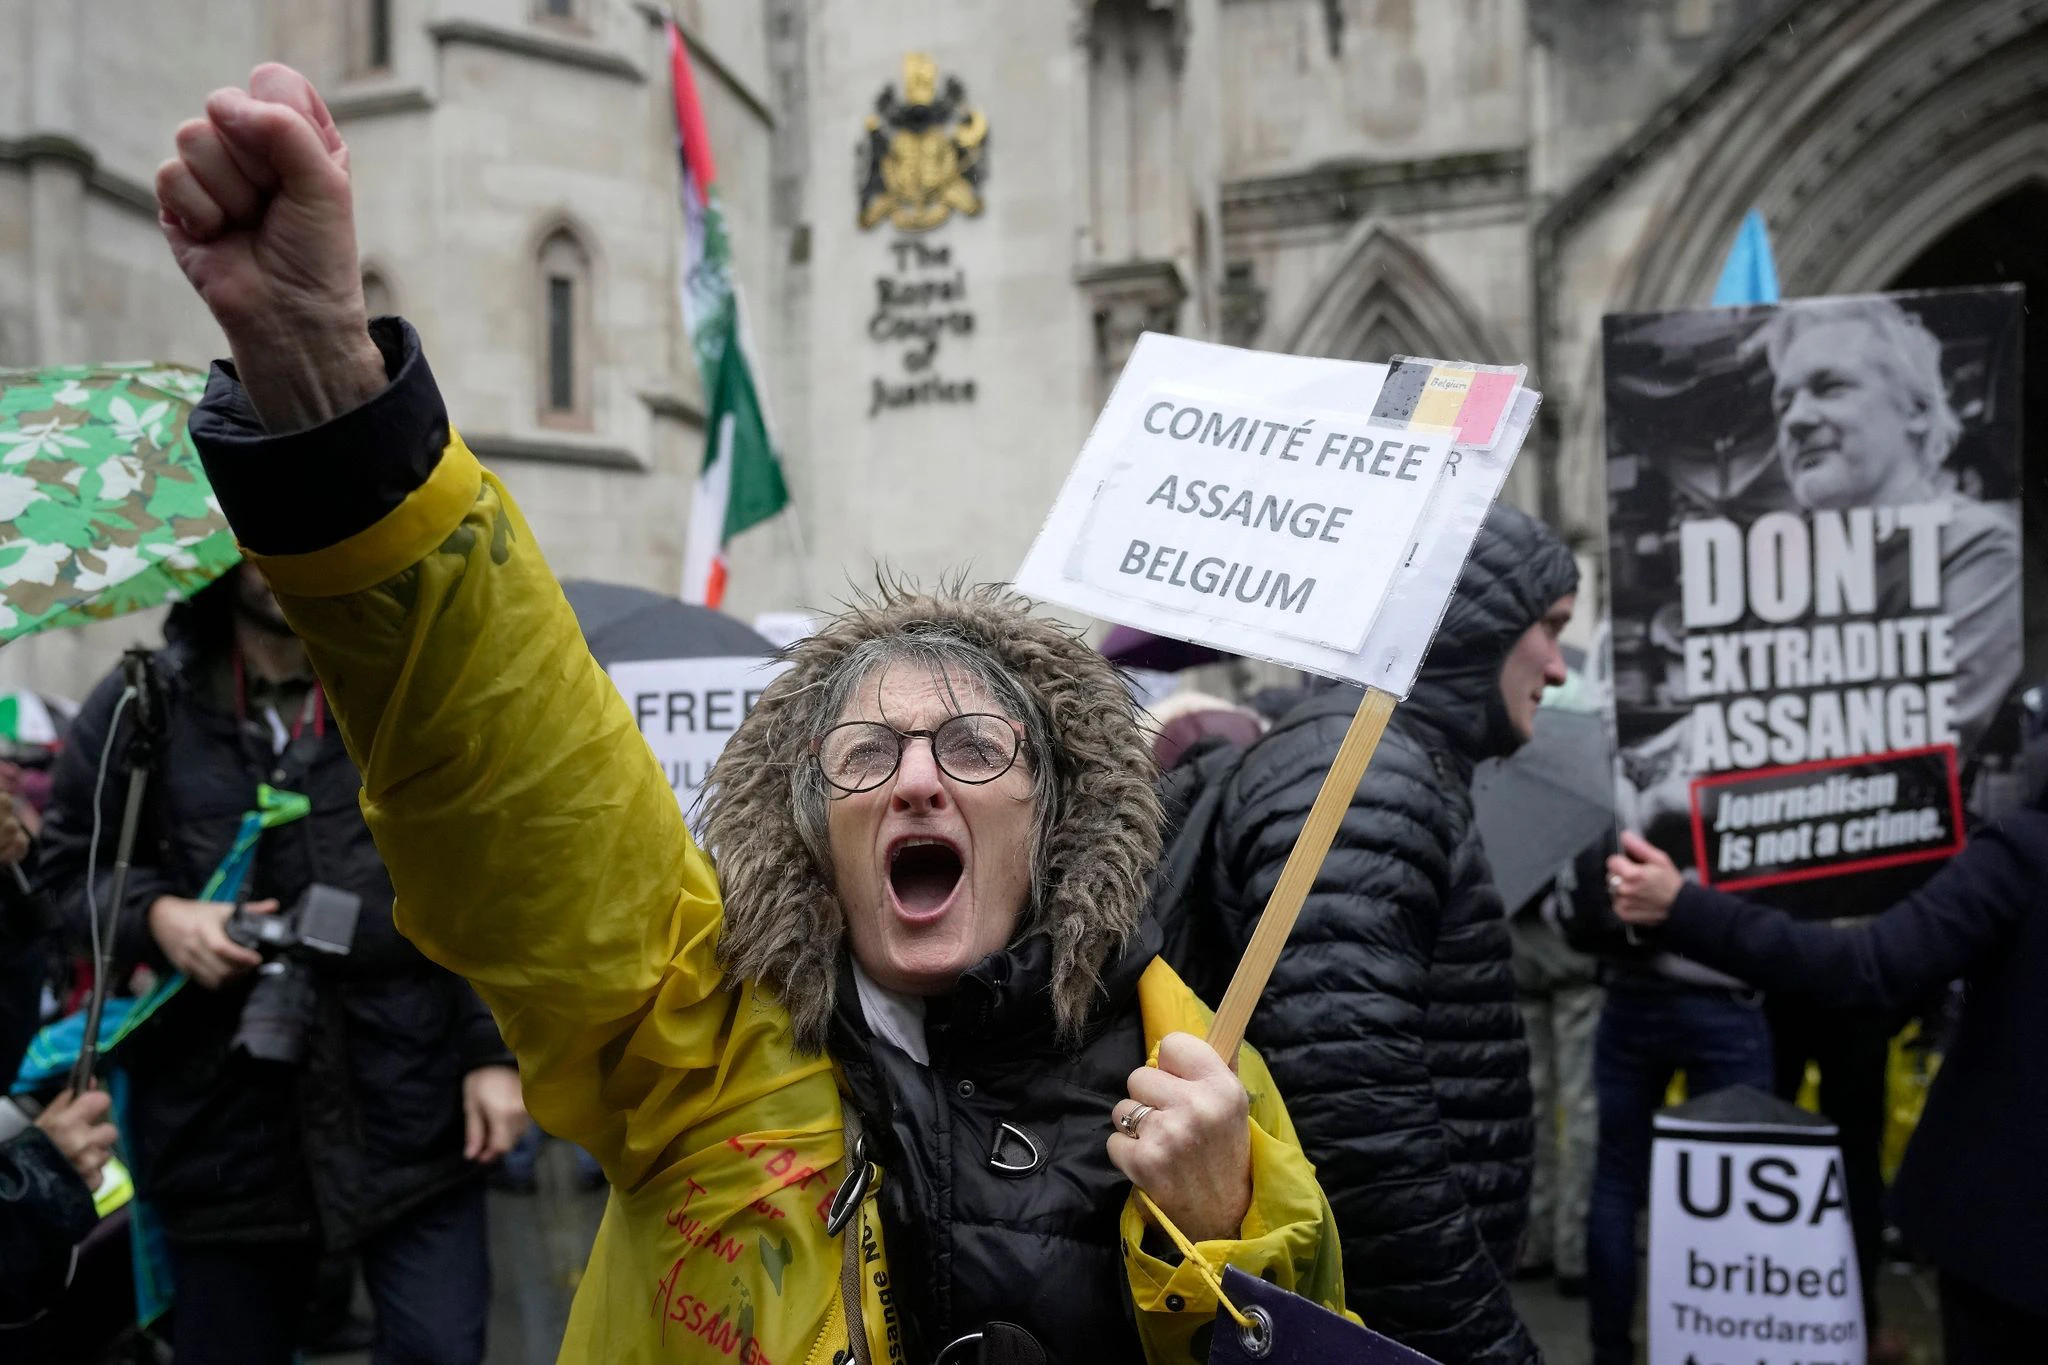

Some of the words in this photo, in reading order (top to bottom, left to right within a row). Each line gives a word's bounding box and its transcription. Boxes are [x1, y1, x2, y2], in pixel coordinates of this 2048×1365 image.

[1430, 376, 1468, 390] Belgium
[1143, 402, 1316, 461] COMITÉ
[1315, 433, 1430, 481] FREE
[1146, 474, 1353, 544] ASSANGE
[1119, 539, 1316, 614] BELGIUM
[1680, 504, 1953, 627] DON'T
[1684, 615, 1955, 696] EXTRADITE
[1689, 681, 1960, 772] ASSANGE
[1713, 773, 1898, 832] Journalism
[1718, 832, 1753, 872] is
[1754, 823, 1813, 866] not
[1814, 822, 1839, 858] a
[1841, 807, 1946, 853] crime.
[1677, 1151, 1845, 1227] USA
[1688, 1248, 1848, 1298] bribed
